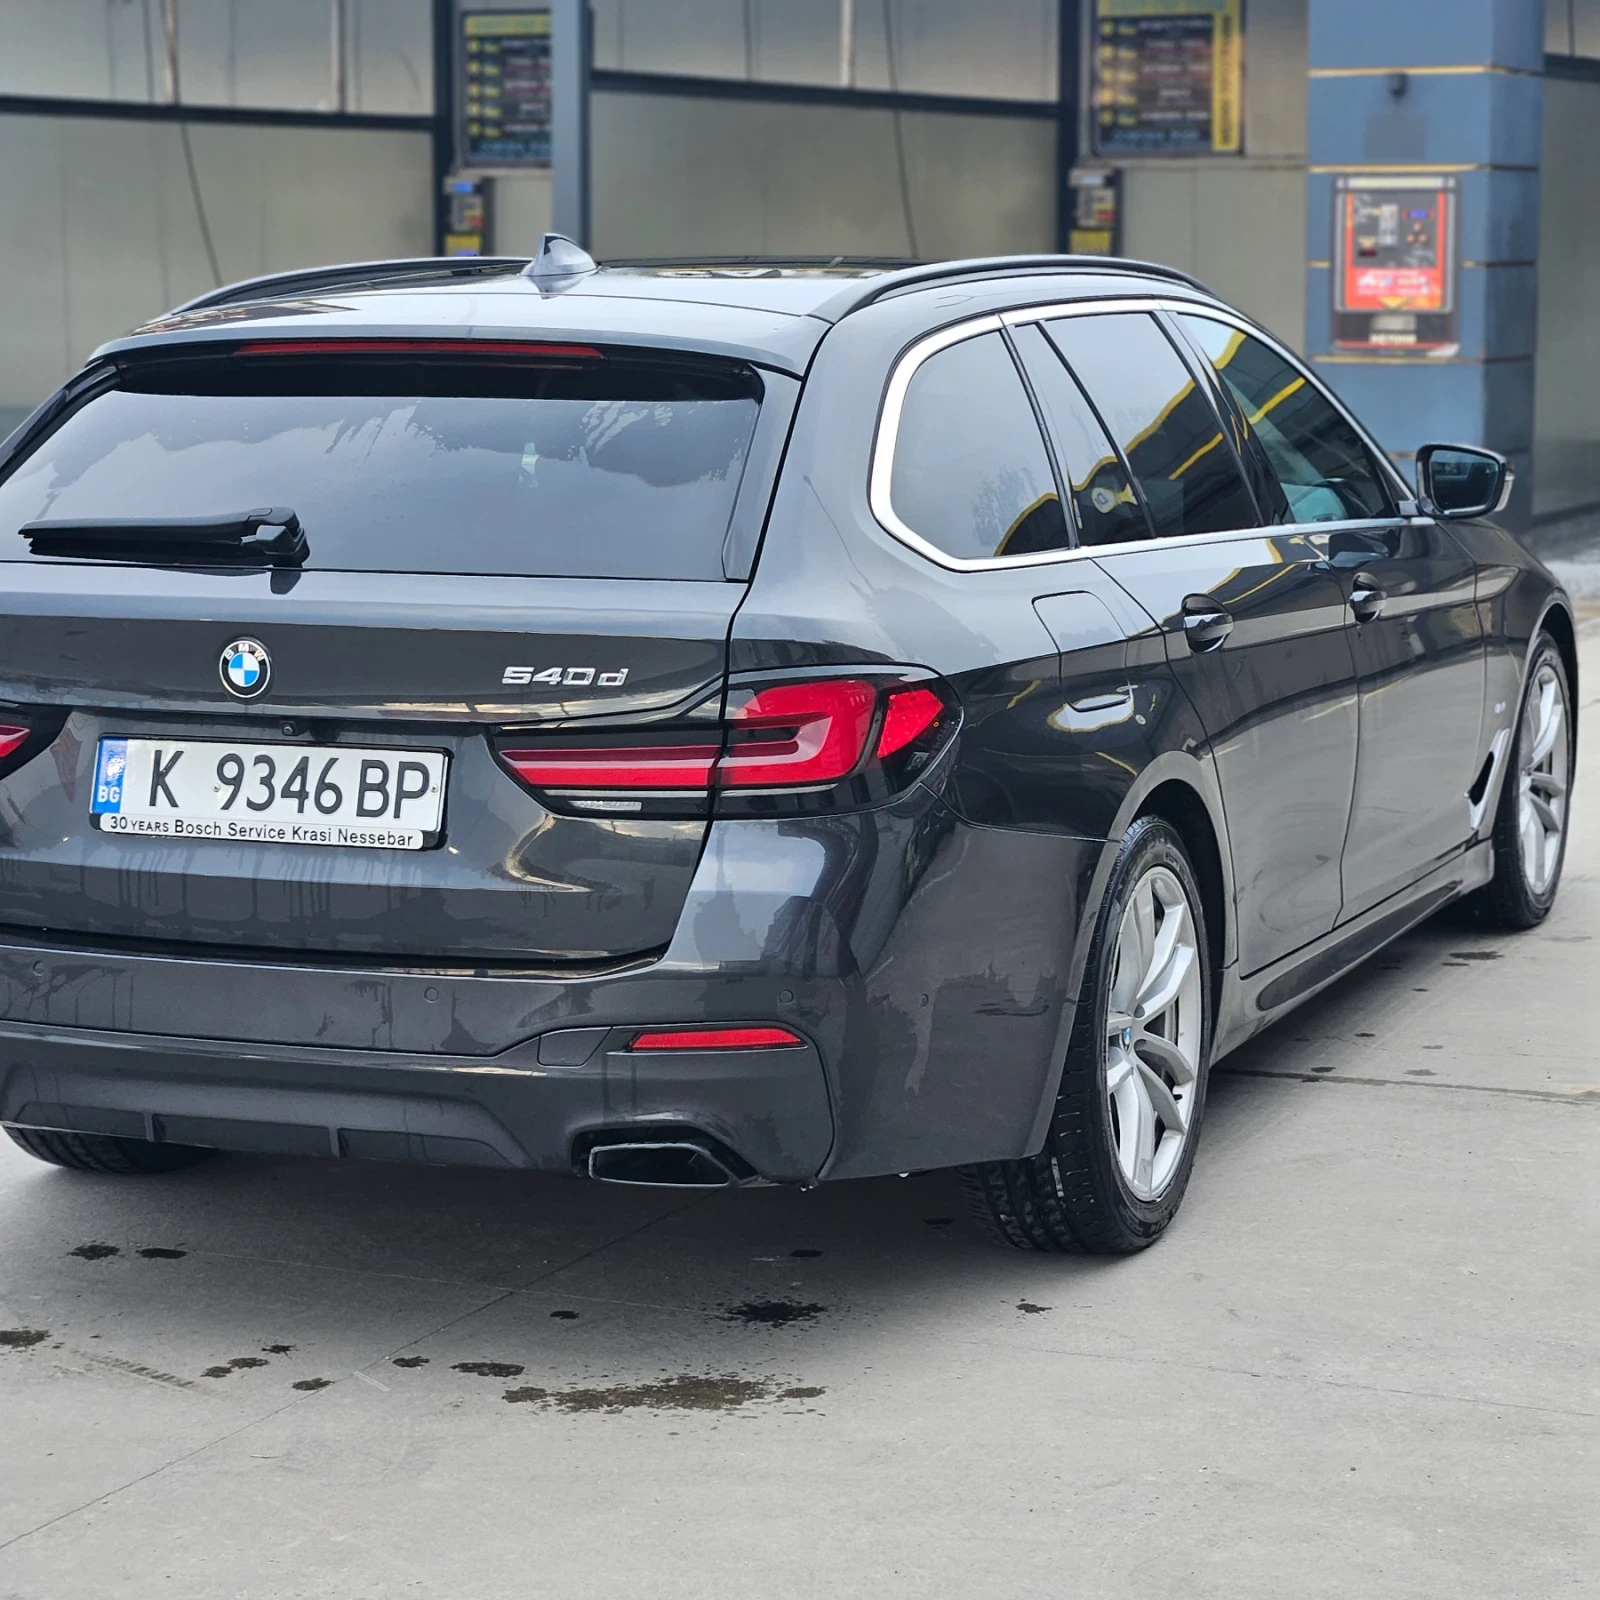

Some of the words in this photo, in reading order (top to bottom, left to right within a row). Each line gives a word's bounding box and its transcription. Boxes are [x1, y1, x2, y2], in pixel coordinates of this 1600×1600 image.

[224, 643, 266, 662] BMW
[97, 785, 121, 803] BG
[148, 749, 185, 808] K
[216, 753, 343, 815] 9346
[355, 759, 430, 819] BP
[110, 815, 128, 830] 30
[130, 819, 169, 833] YEARS
[174, 819, 222, 836] Bosch
[227, 822, 286, 839] Service
[292, 825, 332, 843] Krasi
[338, 828, 414, 847] Nessebar
